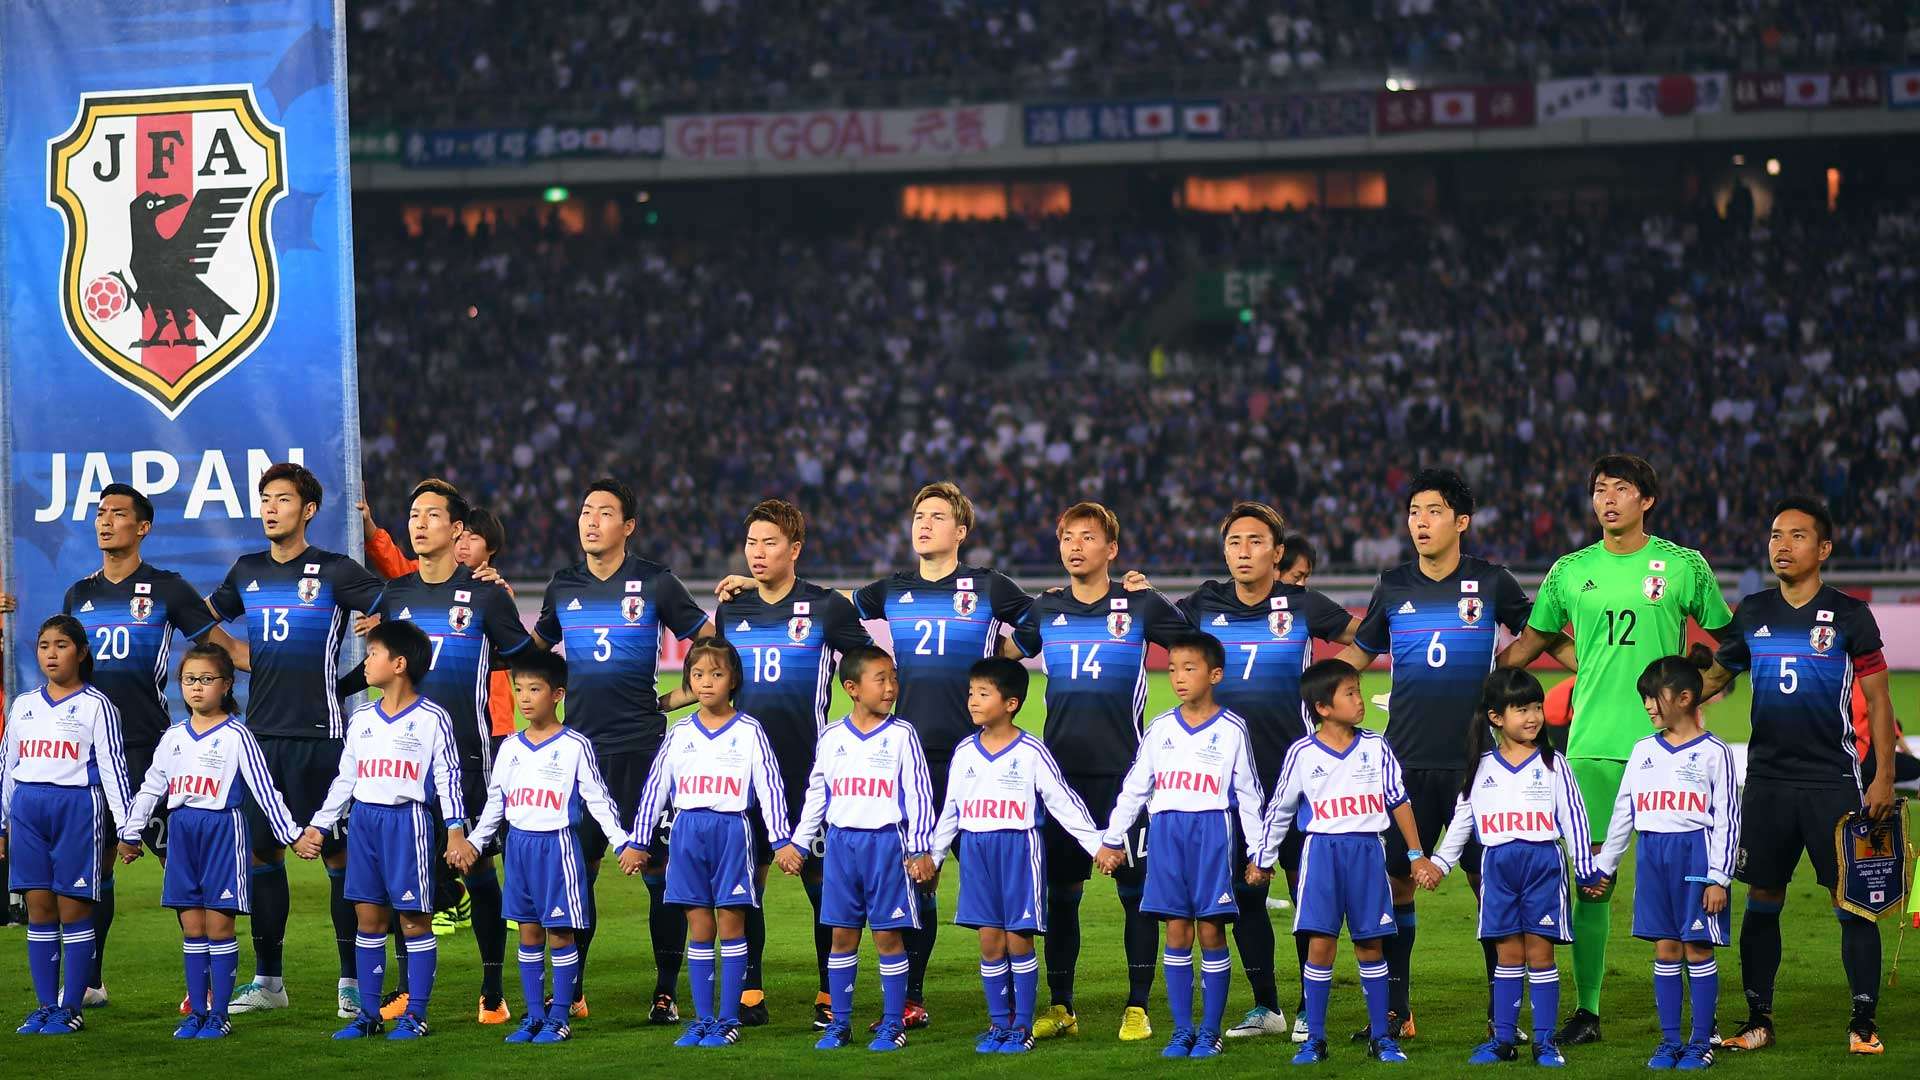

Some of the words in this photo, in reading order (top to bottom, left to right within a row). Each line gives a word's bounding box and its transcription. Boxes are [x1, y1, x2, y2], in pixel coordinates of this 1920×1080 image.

[93, 127, 247, 183] JFA
[262, 608, 289, 642] 13
[914, 618, 948, 656] 21
[1605, 609, 1636, 646] 12
[96, 626, 130, 661] 20
[593, 627, 612, 662] 3
[1426, 631, 1447, 668] 6
[752, 647, 782, 683] 18
[1070, 643, 1102, 680] 14
[1240, 643, 1258, 680] 7
[1779, 656, 1799, 694] 5
[18, 740, 80, 761] KIRIN
[357, 758, 420, 782] KIRIN
[1155, 771, 1221, 795] KIRIN
[169, 775, 221, 799] KIRIN
[506, 788, 564, 811] KIRIN
[678, 774, 742, 797] KIRIN
[831, 777, 894, 799] KIRIN
[962, 799, 1026, 820] KIRIN
[1313, 793, 1384, 820] KIRIN
[1636, 790, 1707, 813] KIRIN
[1481, 811, 1554, 834] KIRIN
